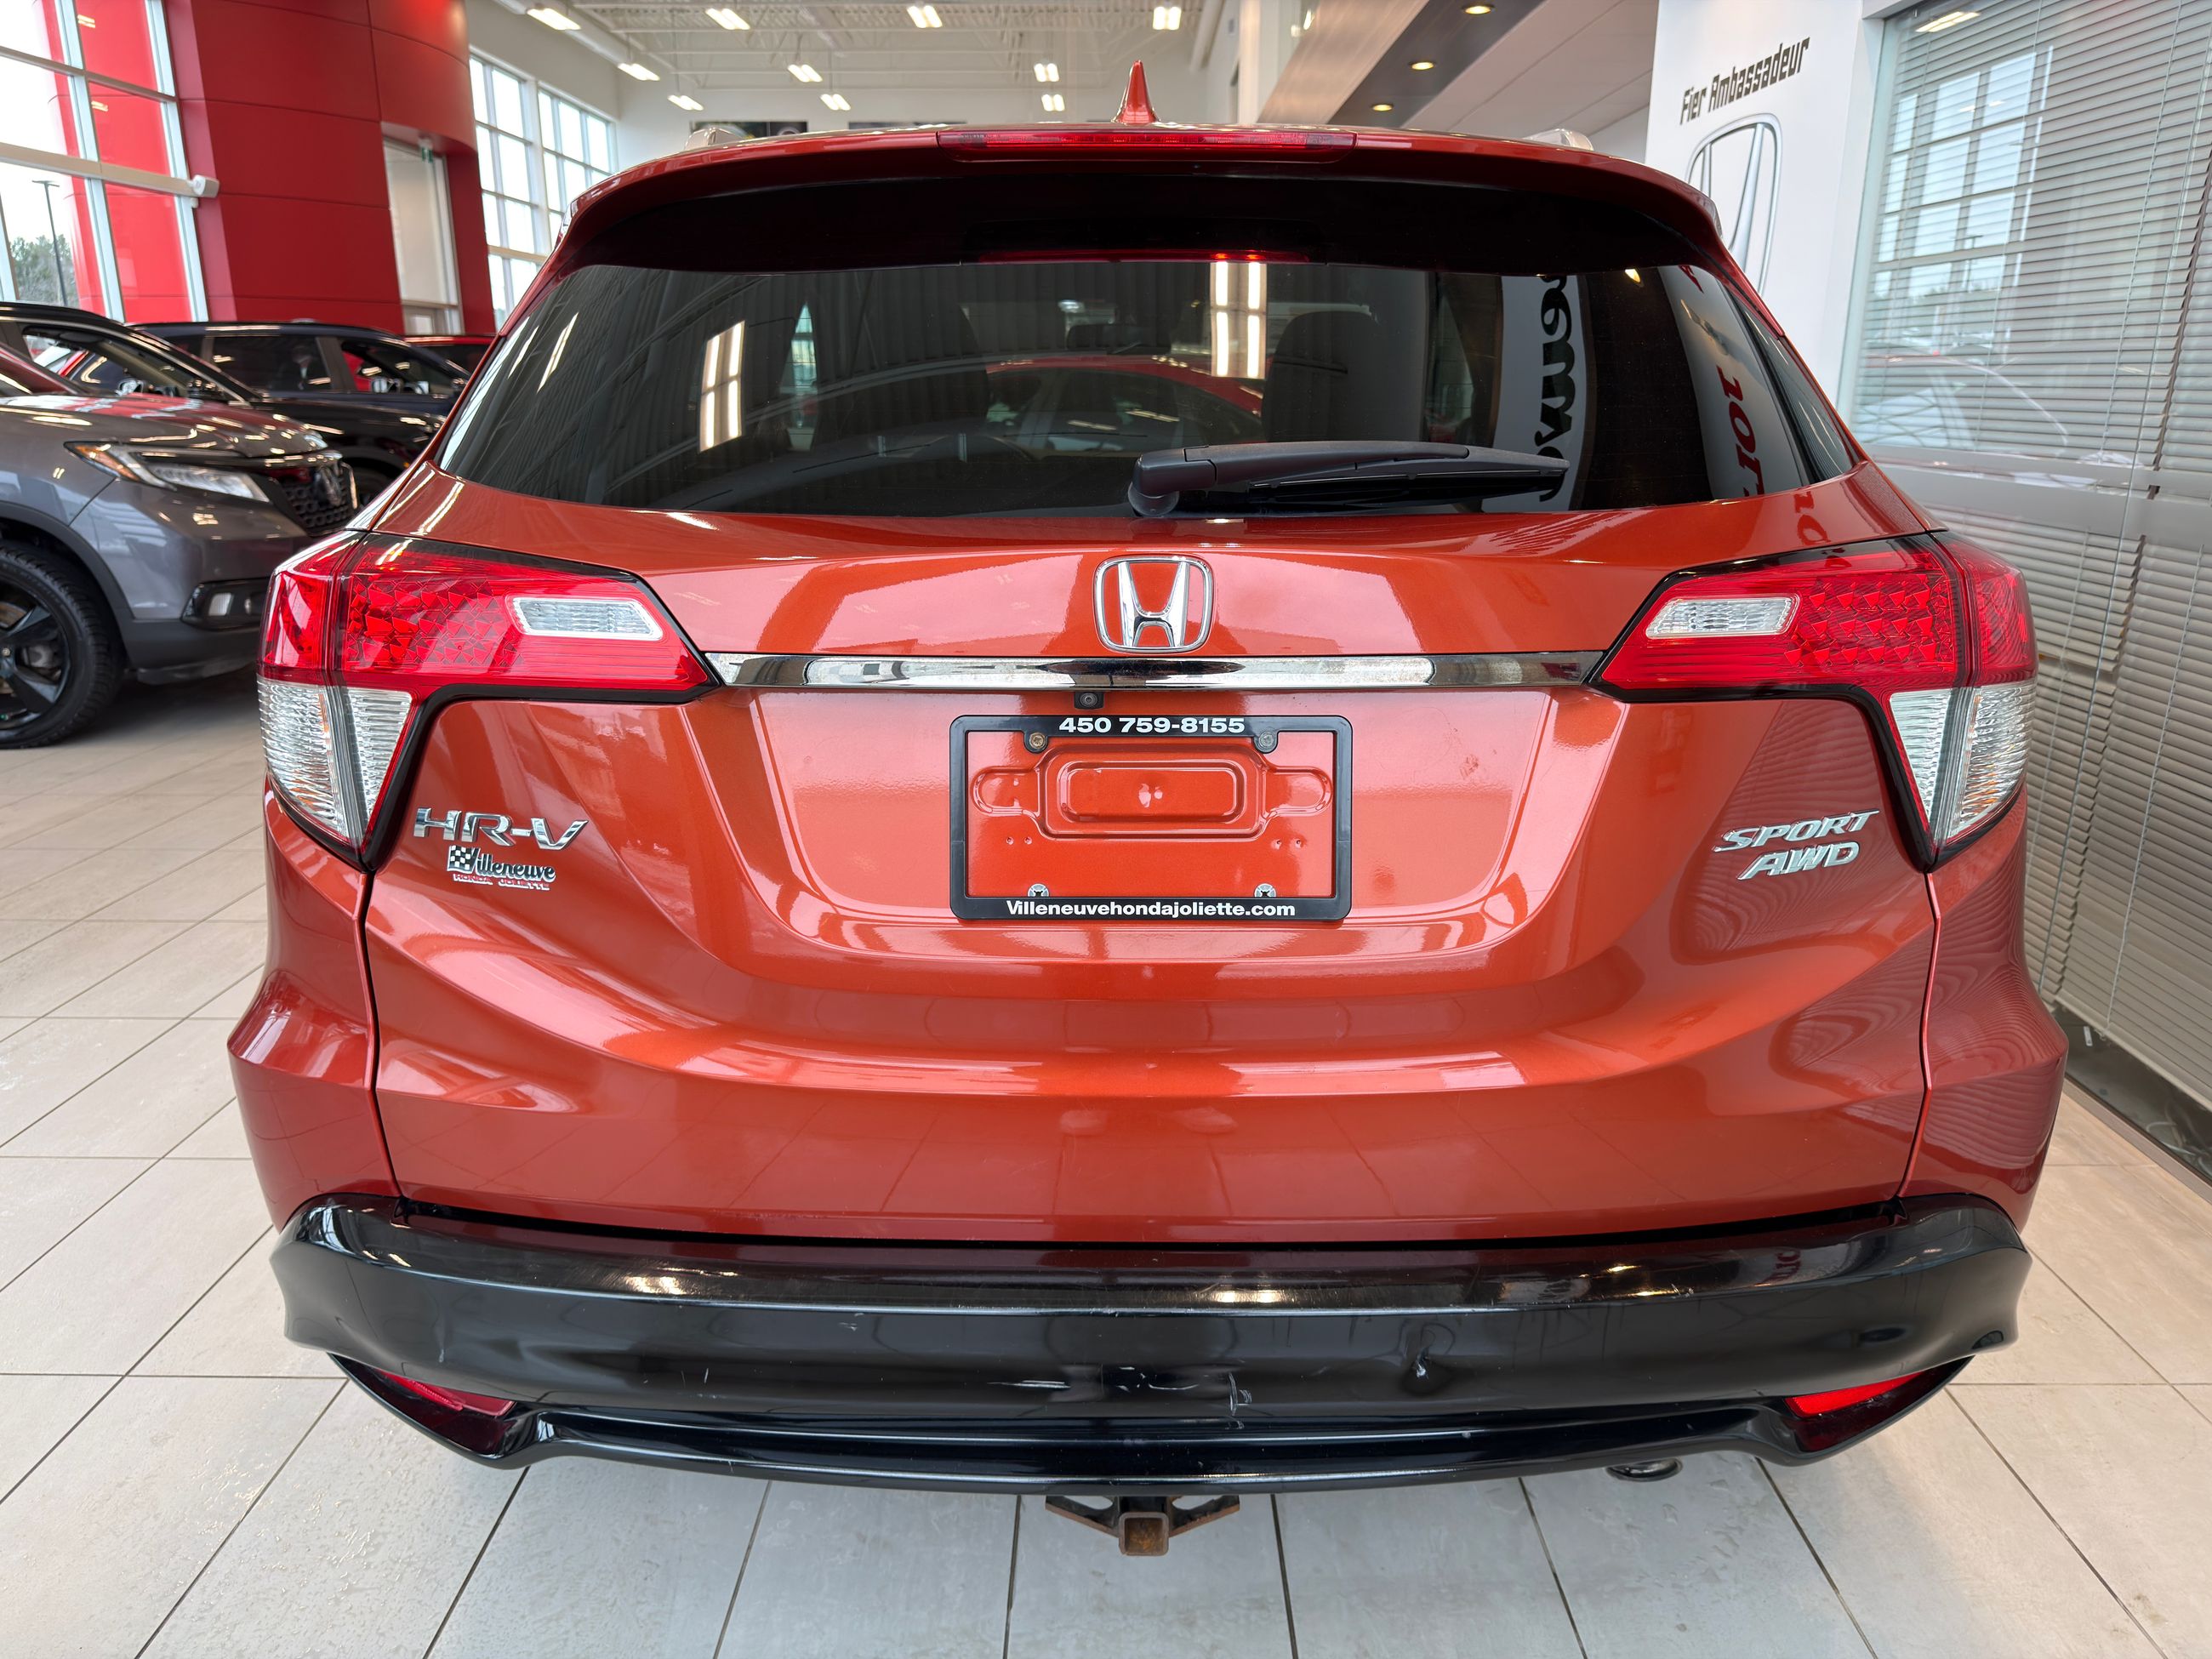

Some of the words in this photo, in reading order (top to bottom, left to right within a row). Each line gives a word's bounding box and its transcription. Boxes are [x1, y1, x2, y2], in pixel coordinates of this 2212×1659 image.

[1679, 86, 1707, 125] Fier
[1707, 37, 1810, 112] Ambassadeur
[1059, 717, 1111, 733] 450
[1119, 717, 1245, 733] 759-8155
[413, 807, 589, 850] HR-V
[1712, 808, 1879, 852] SPORT
[448, 845, 556, 882] Villeneuve
[1736, 841, 1860, 881] AWD
[1006, 900, 1295, 918] Villeneuvehondajoliette.com
